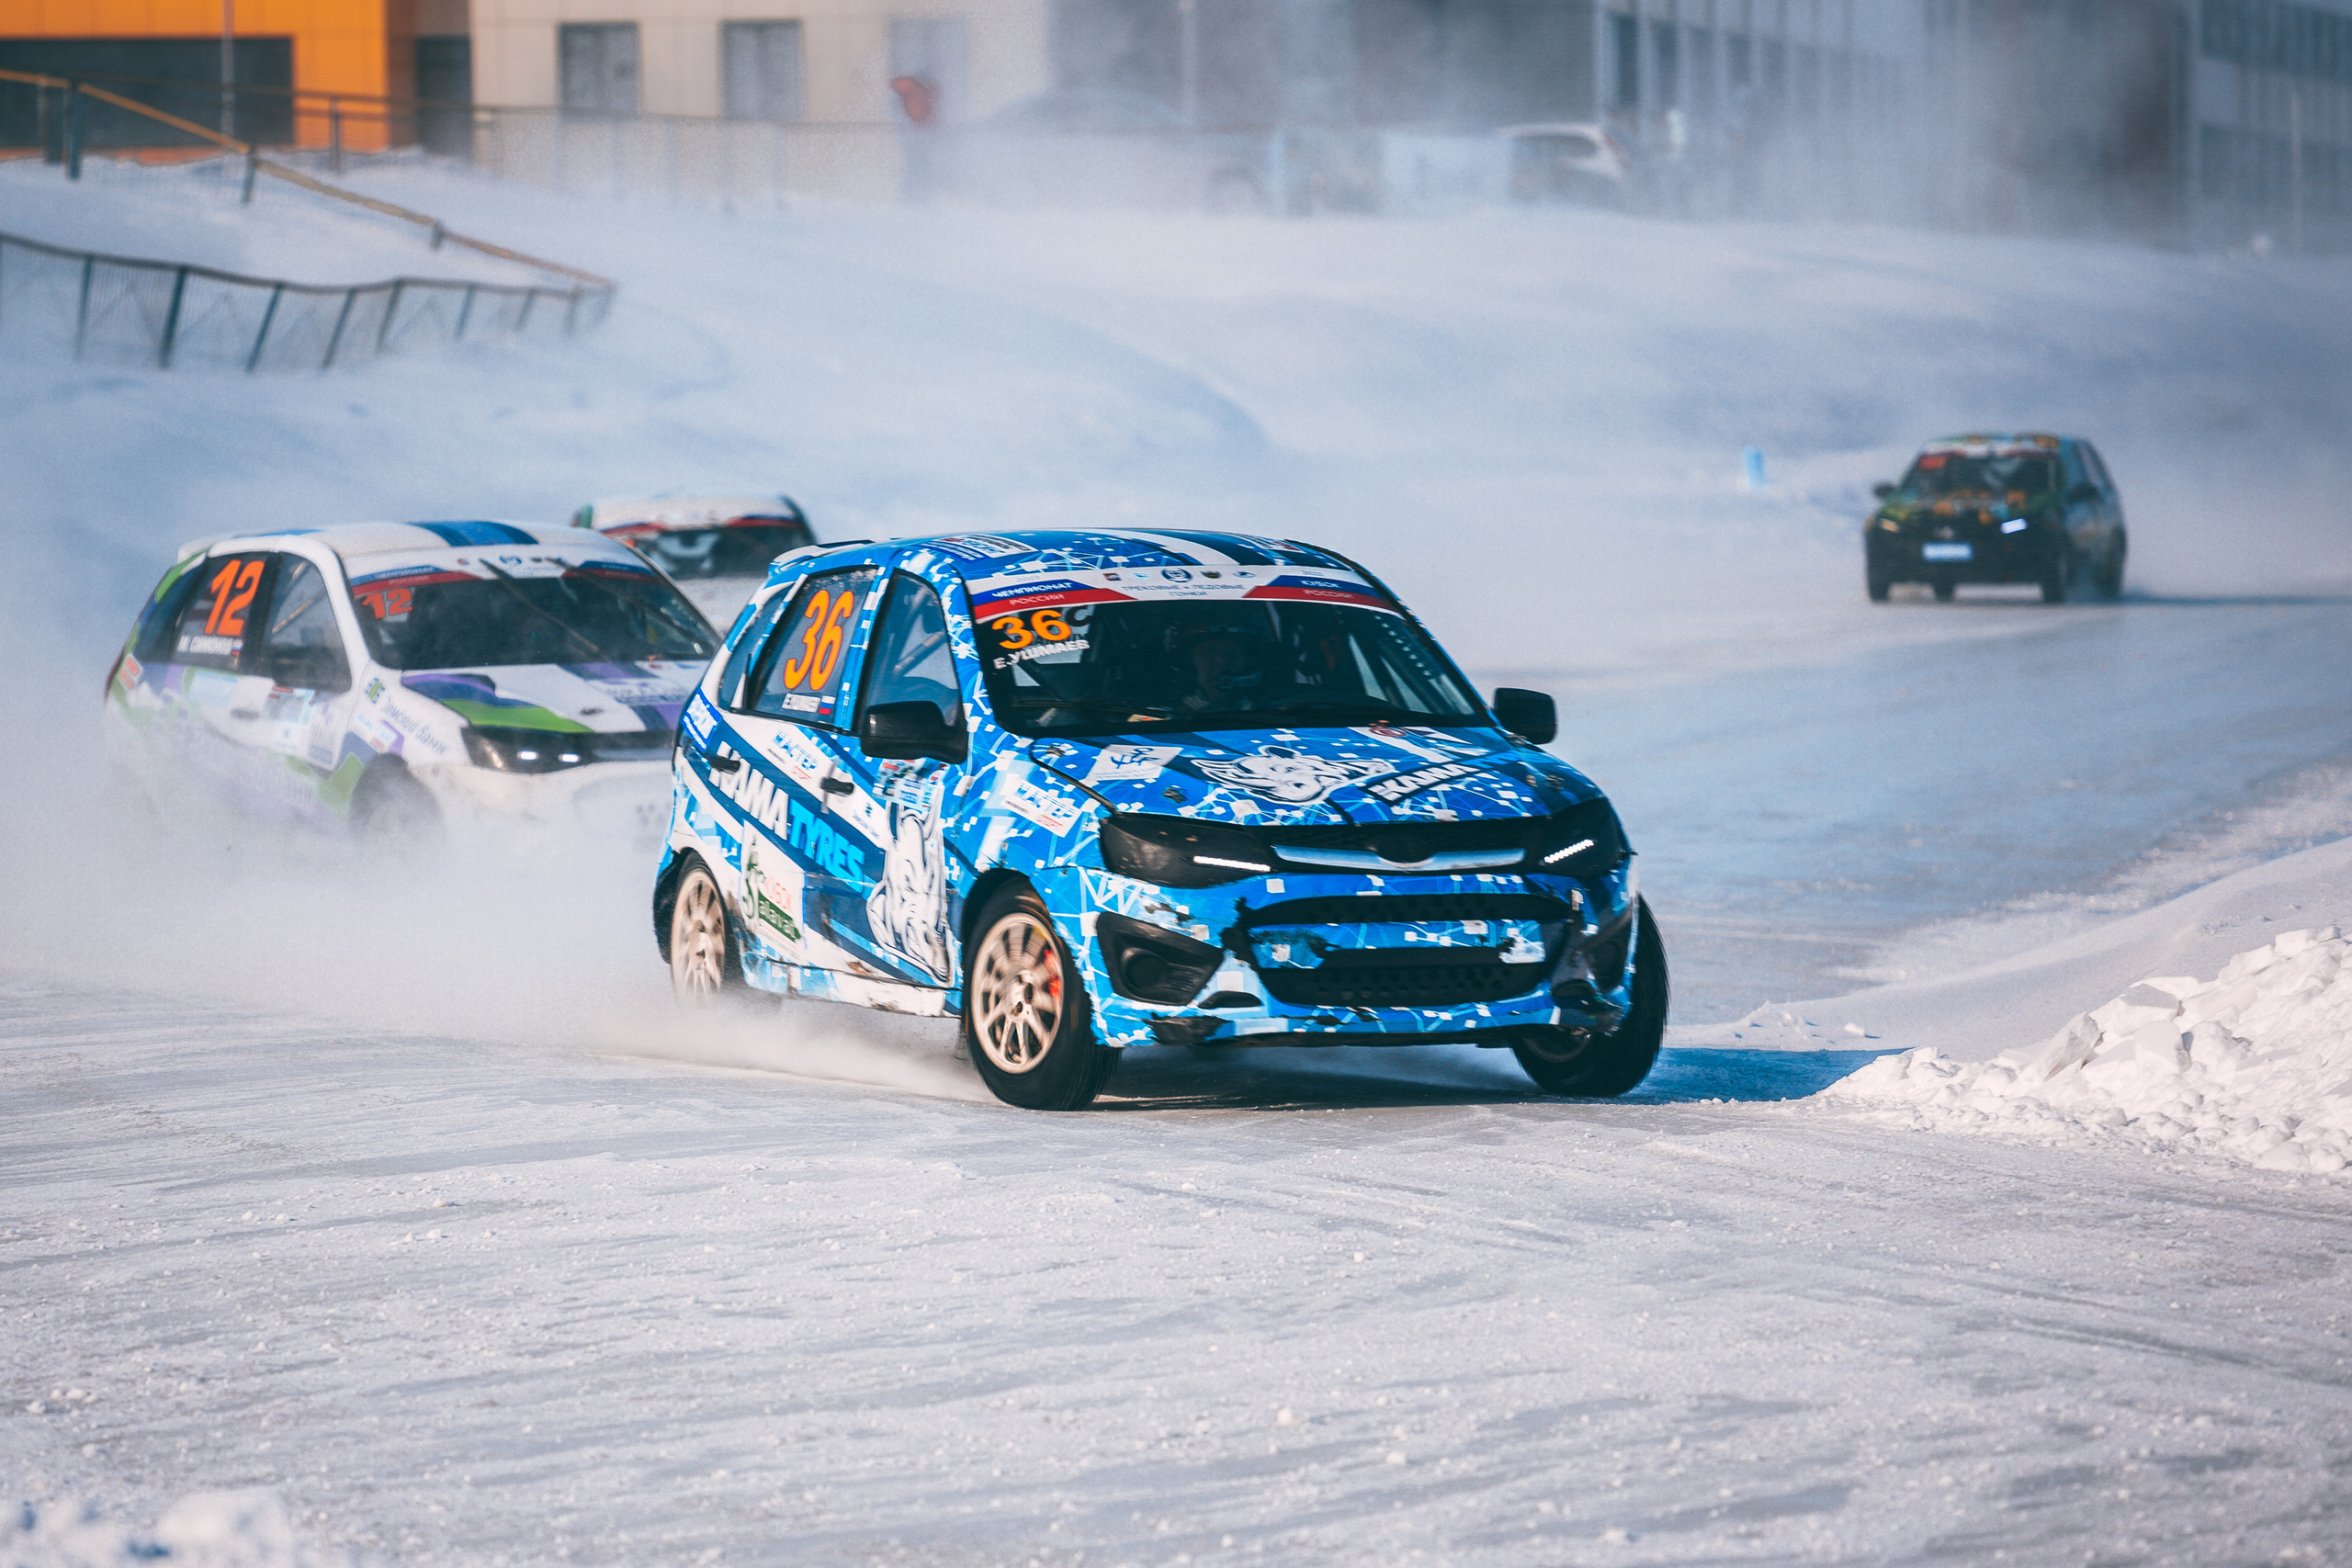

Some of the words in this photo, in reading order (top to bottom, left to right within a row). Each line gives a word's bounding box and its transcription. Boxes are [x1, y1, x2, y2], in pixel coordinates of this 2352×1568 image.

[204, 559, 265, 637] 12
[361, 588, 413, 620] 12
[992, 582, 1073, 597] ЧЕМПИОНАТ
[1010, 593, 1066, 605] РОССИИ
[784, 589, 853, 692] 36
[991, 609, 1072, 649] 36
[1367, 763, 1482, 802] KAMA
[789, 797, 865, 894] TYRES
